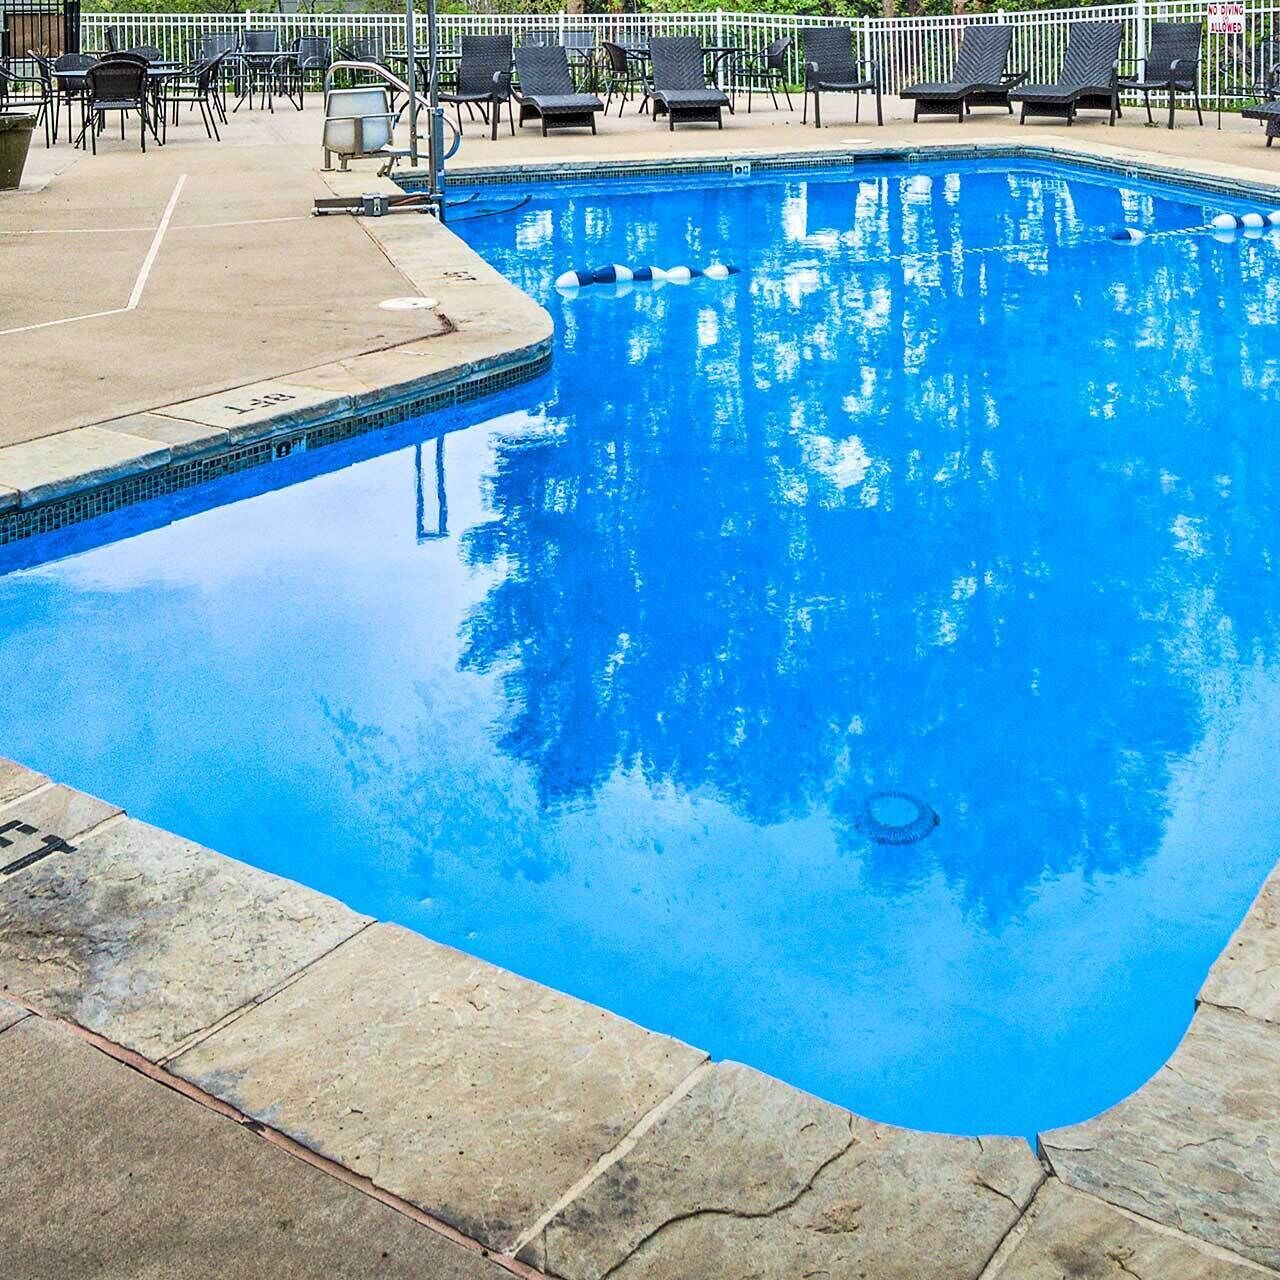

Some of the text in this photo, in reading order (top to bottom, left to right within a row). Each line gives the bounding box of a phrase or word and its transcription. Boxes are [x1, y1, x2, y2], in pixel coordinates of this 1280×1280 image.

[1207, 5, 1244, 16] NO DIVING
[1210, 22, 1243, 33] ALLOWED
